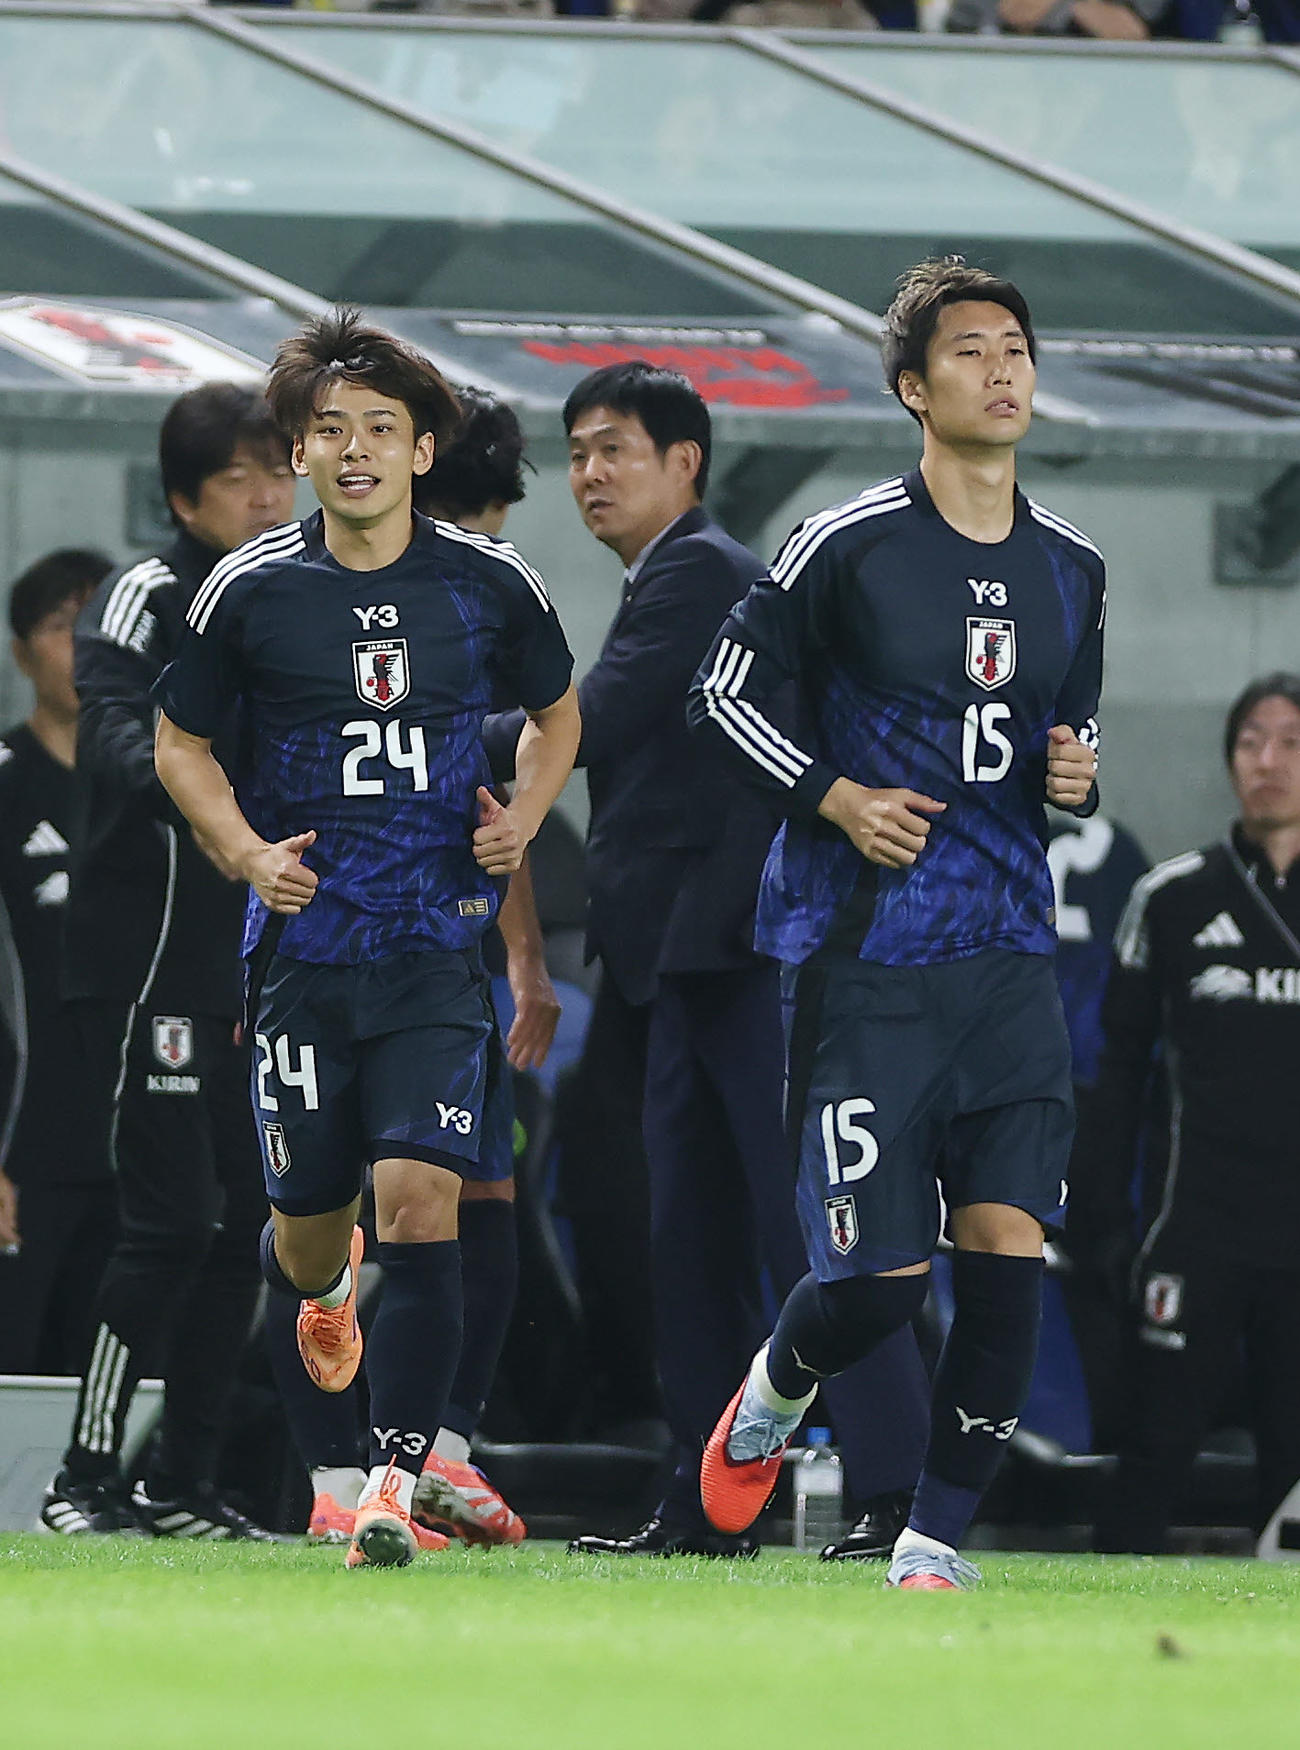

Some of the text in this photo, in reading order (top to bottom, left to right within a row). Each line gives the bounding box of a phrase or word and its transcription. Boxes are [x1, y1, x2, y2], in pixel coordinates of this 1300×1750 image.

[966, 579, 1008, 606] Y-3
[352, 605, 399, 630] Y-3
[366, 643, 394, 651] JAPAN
[341, 719, 428, 796] 24
[962, 703, 1014, 782] 15
[1255, 966, 1300, 1004] KI
[147, 1074, 200, 1093] KIRIN
[255, 1033, 319, 1112] 24
[435, 1101, 473, 1134] Y-3
[821, 1098, 879, 1185] 15
[956, 1406, 1019, 1440] Y-3
[373, 1427, 427, 1455] Y-3
